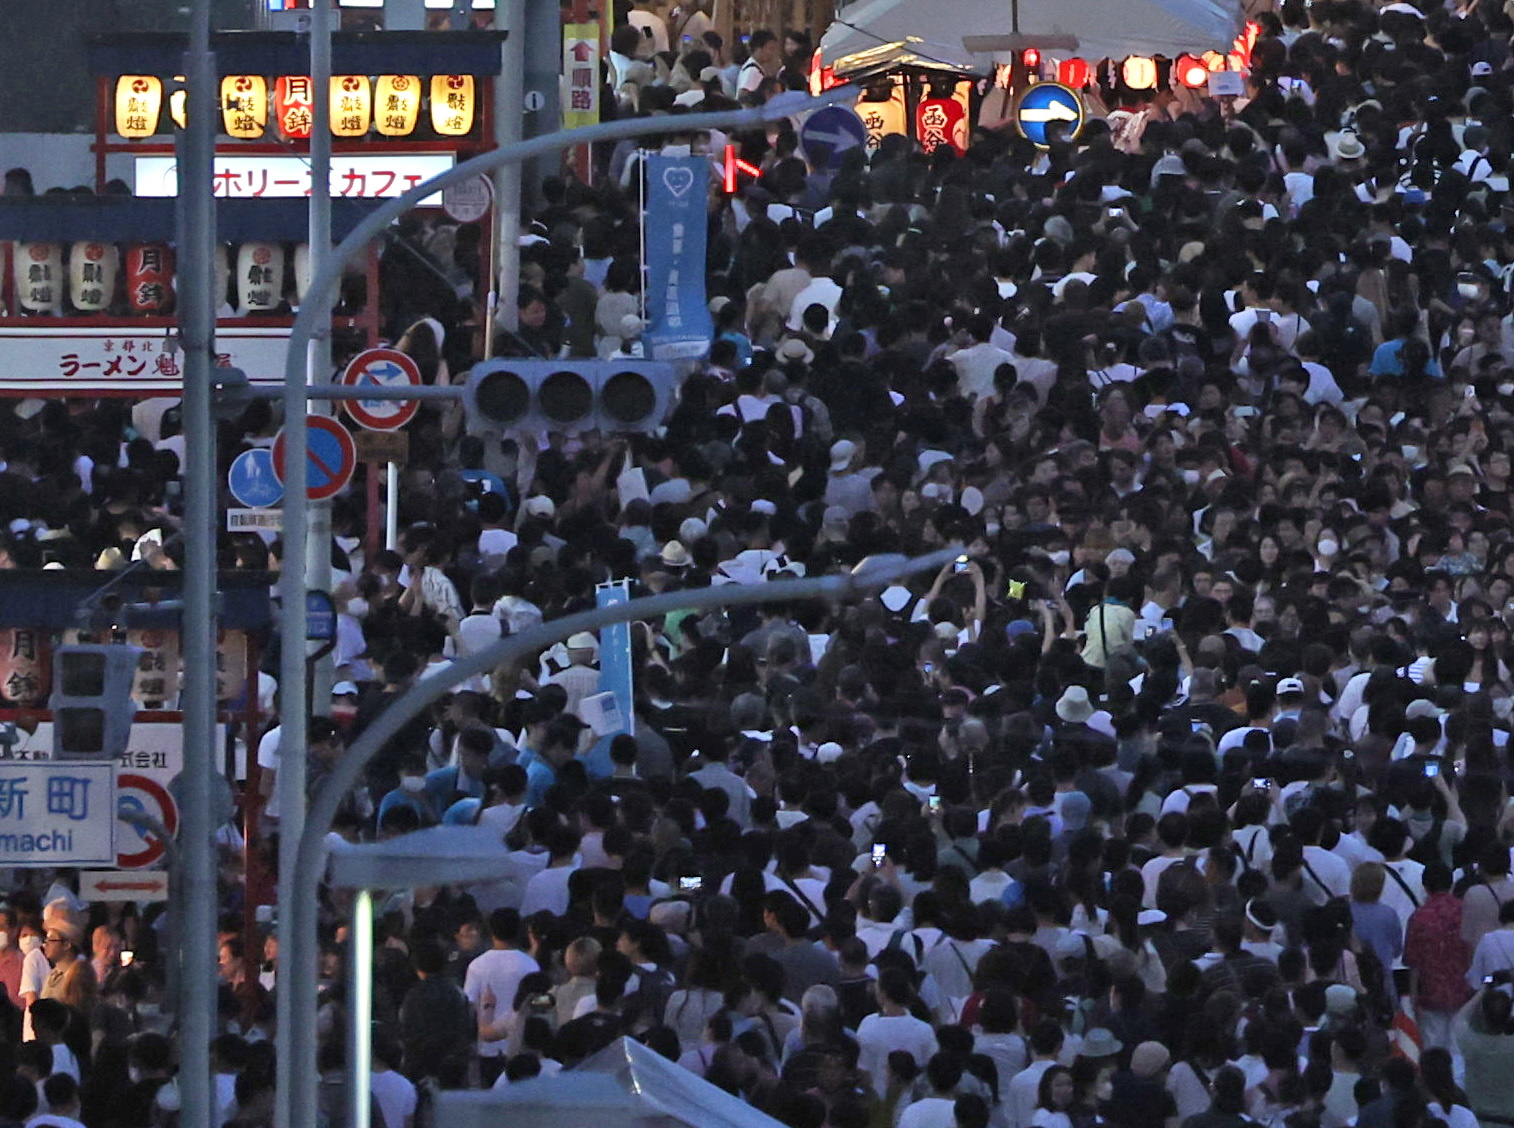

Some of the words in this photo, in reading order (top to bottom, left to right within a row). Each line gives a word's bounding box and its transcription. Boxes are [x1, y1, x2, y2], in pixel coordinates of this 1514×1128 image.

[213, 168, 422, 196] ホリーカフェ
[136, 248, 164, 307] 月鉾
[0, 828, 73, 852] machi
